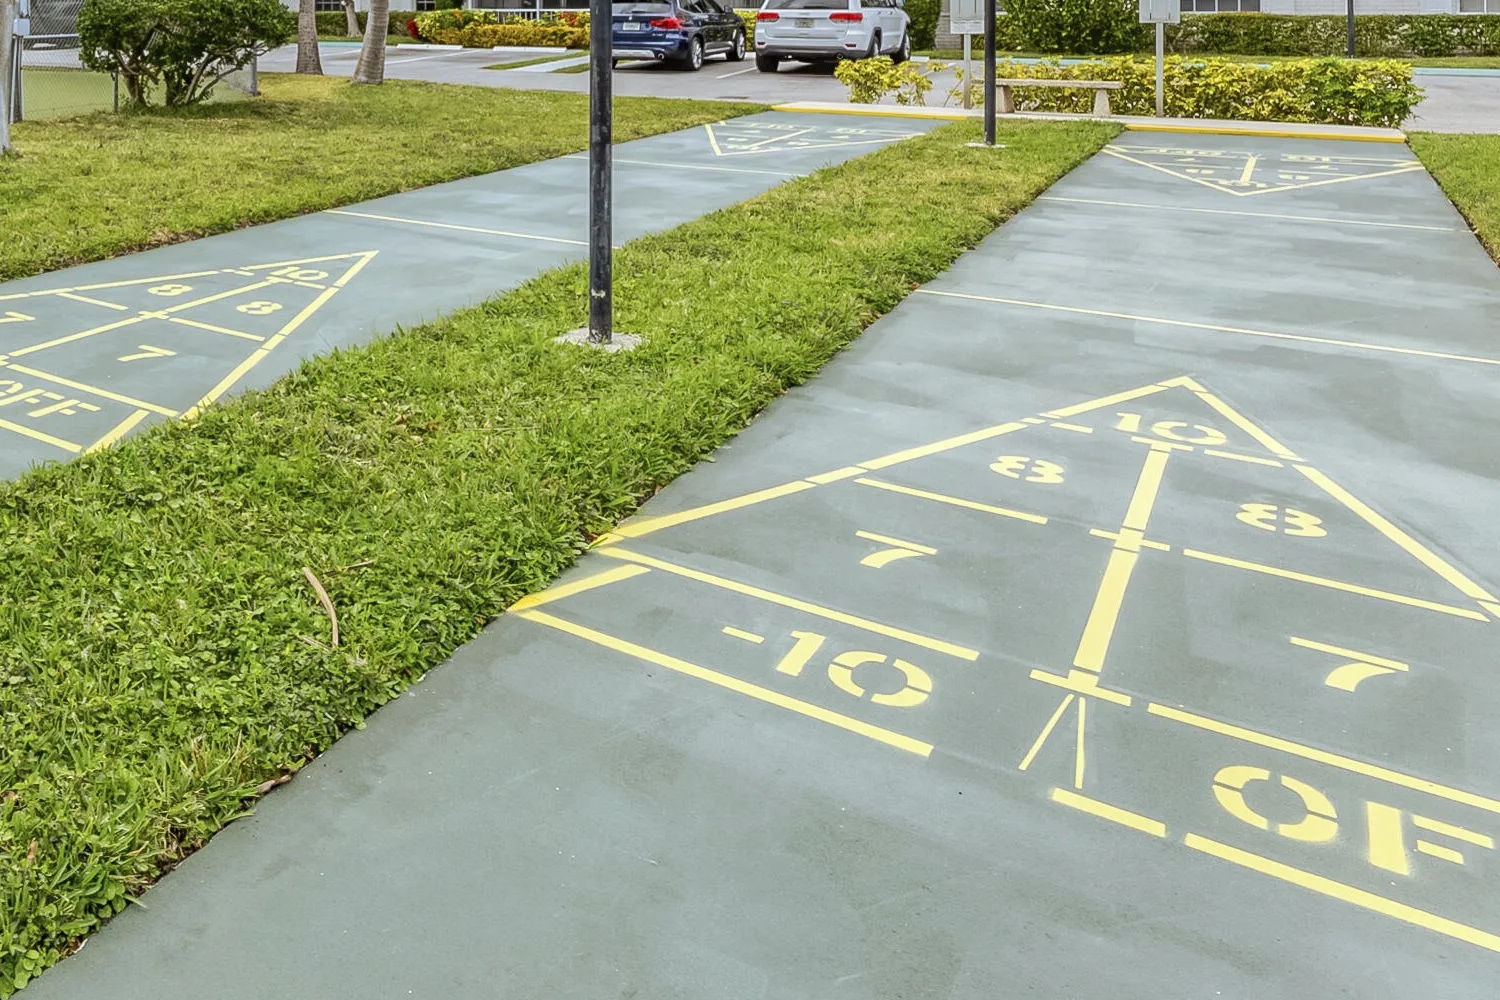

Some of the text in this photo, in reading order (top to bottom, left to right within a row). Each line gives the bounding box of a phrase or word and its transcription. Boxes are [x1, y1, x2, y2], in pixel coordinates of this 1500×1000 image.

[148, 284, 193, 296] 8
[236, 301, 283, 315] 8
[117, 344, 177, 362] 7
[1116, 412, 1228, 446] 10
[989, 455, 1065, 484] 8
[1235, 503, 1328, 537] 8
[855, 529, 938, 568] 7
[721, 625, 934, 707] -10
[1290, 636, 1410, 692] 7
